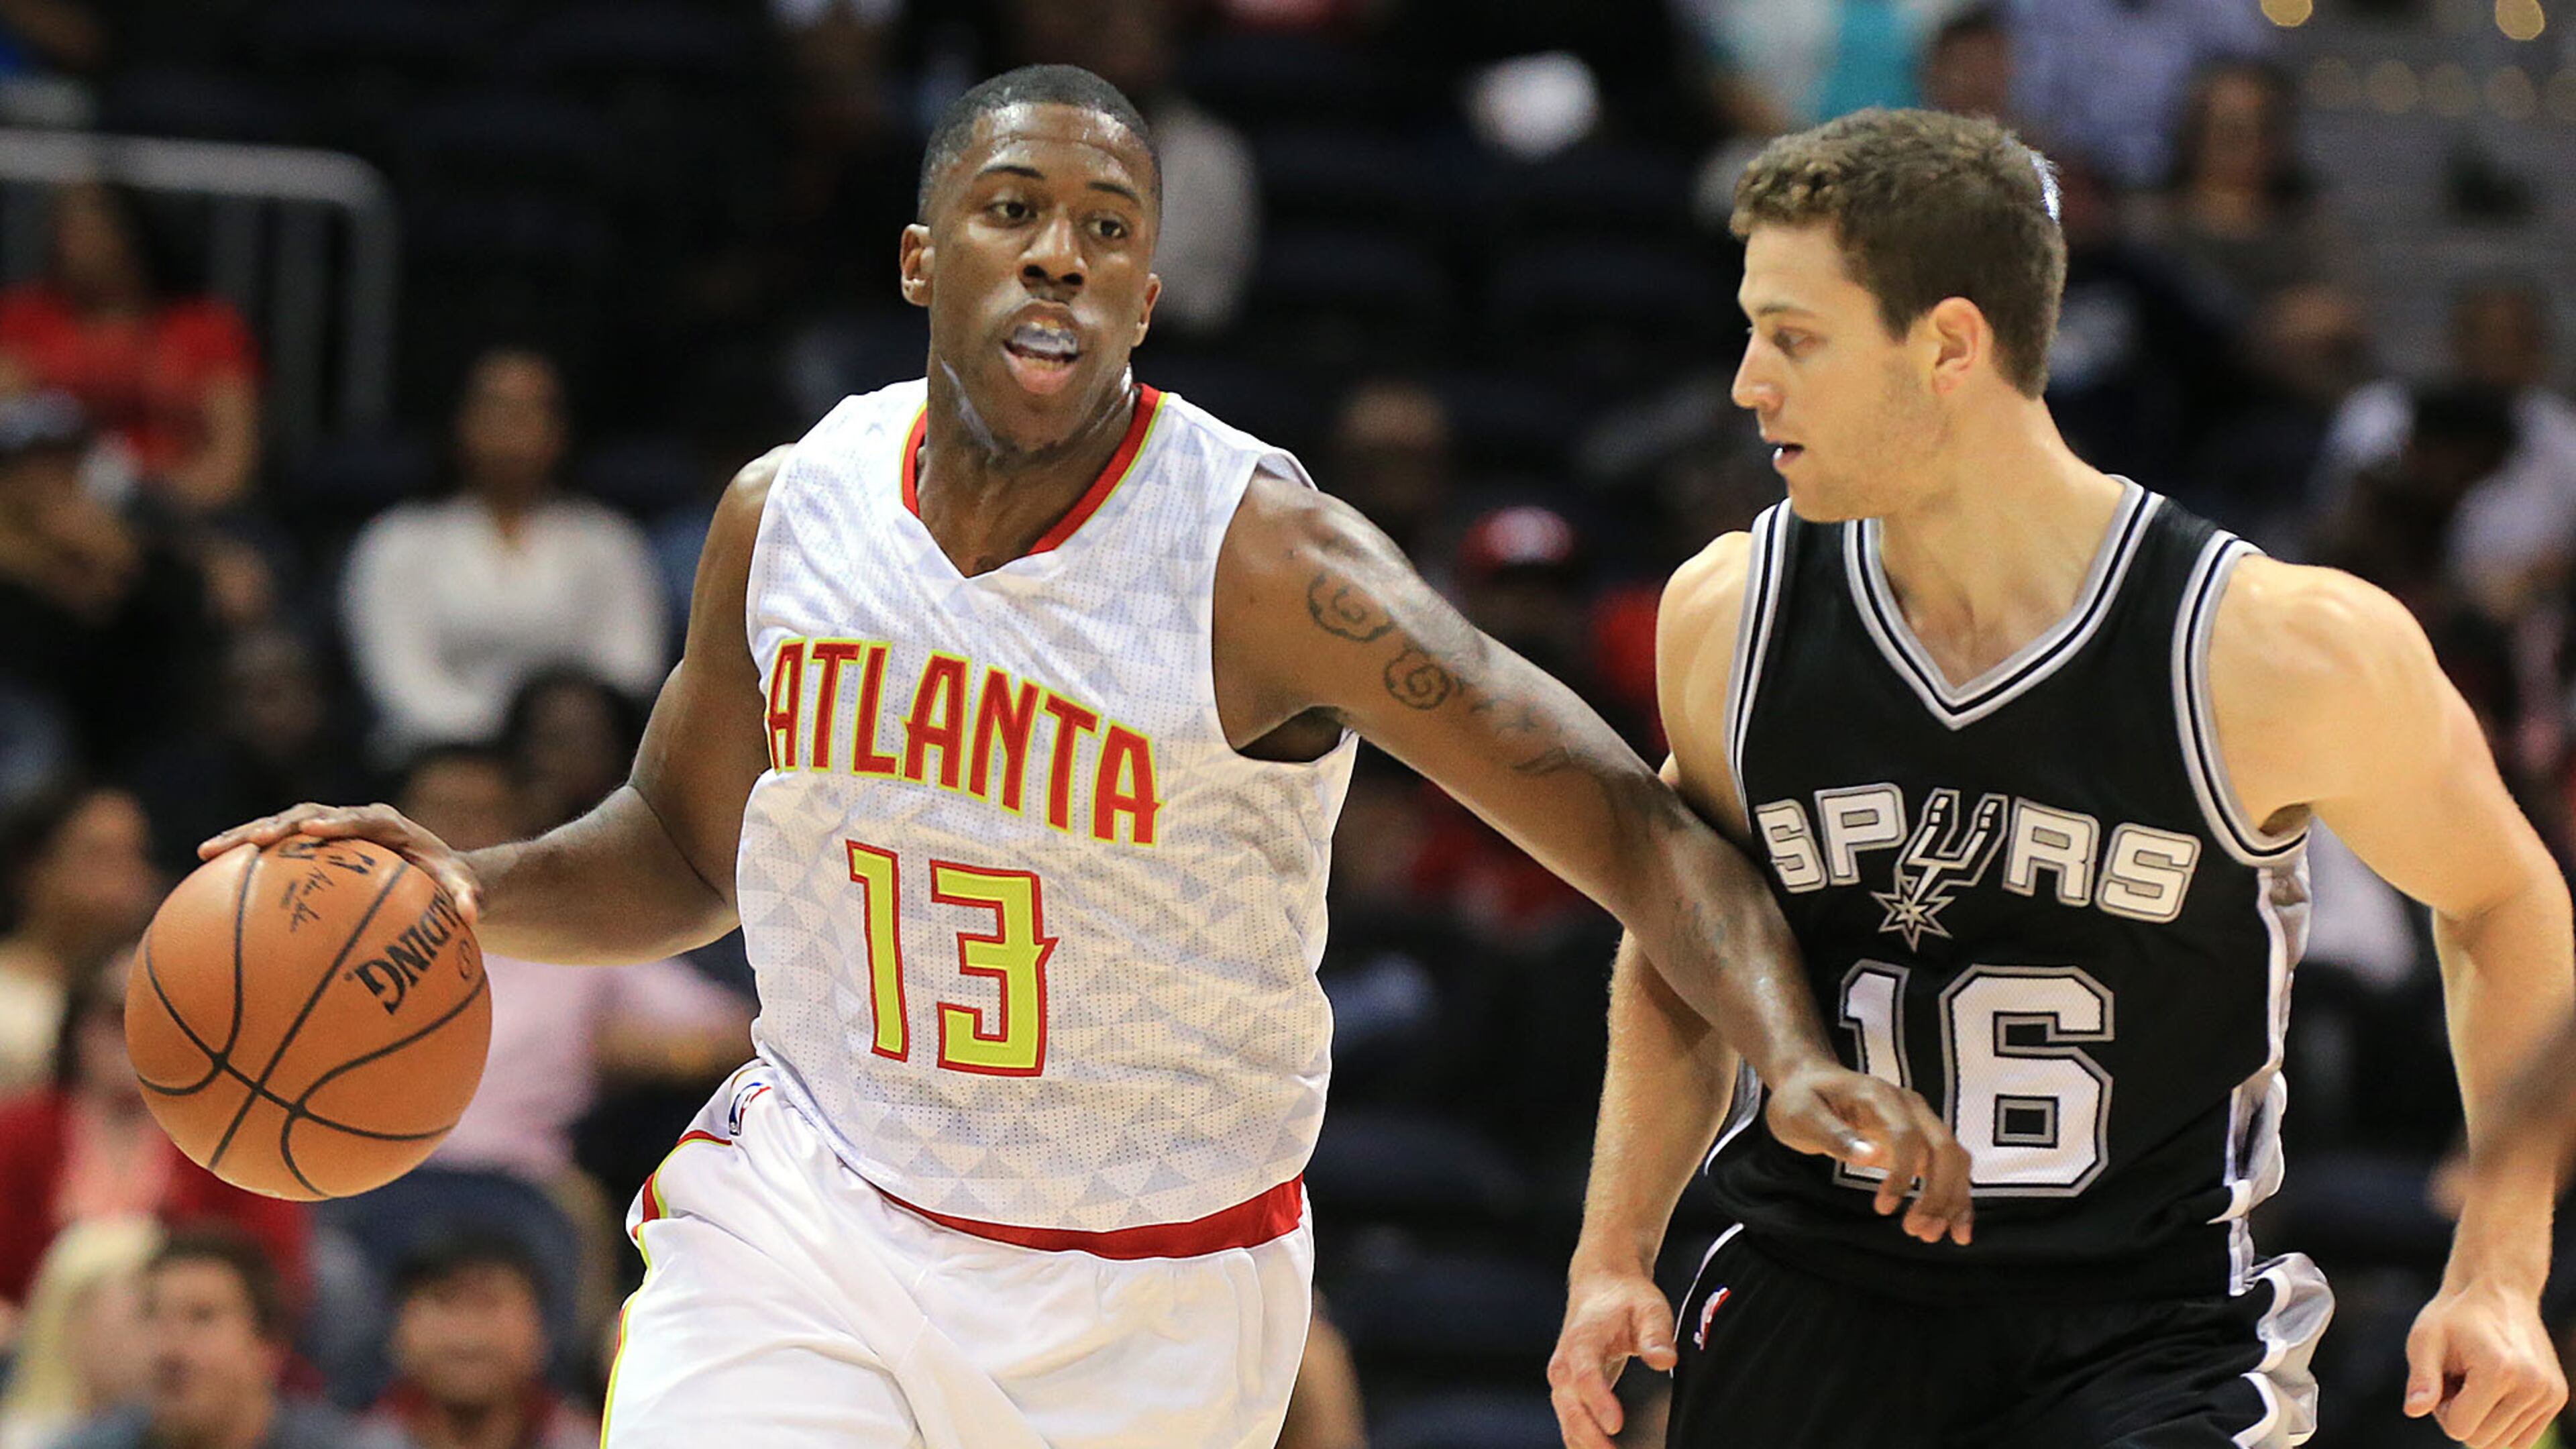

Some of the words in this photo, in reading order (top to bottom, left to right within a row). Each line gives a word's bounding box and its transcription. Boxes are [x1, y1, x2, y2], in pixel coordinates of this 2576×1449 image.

[765, 637, 1166, 847] ATLANTA
[845, 839, 1059, 1077] 13
[1755, 782, 2202, 953] SPURS
[1833, 958, 2114, 1197] 16
